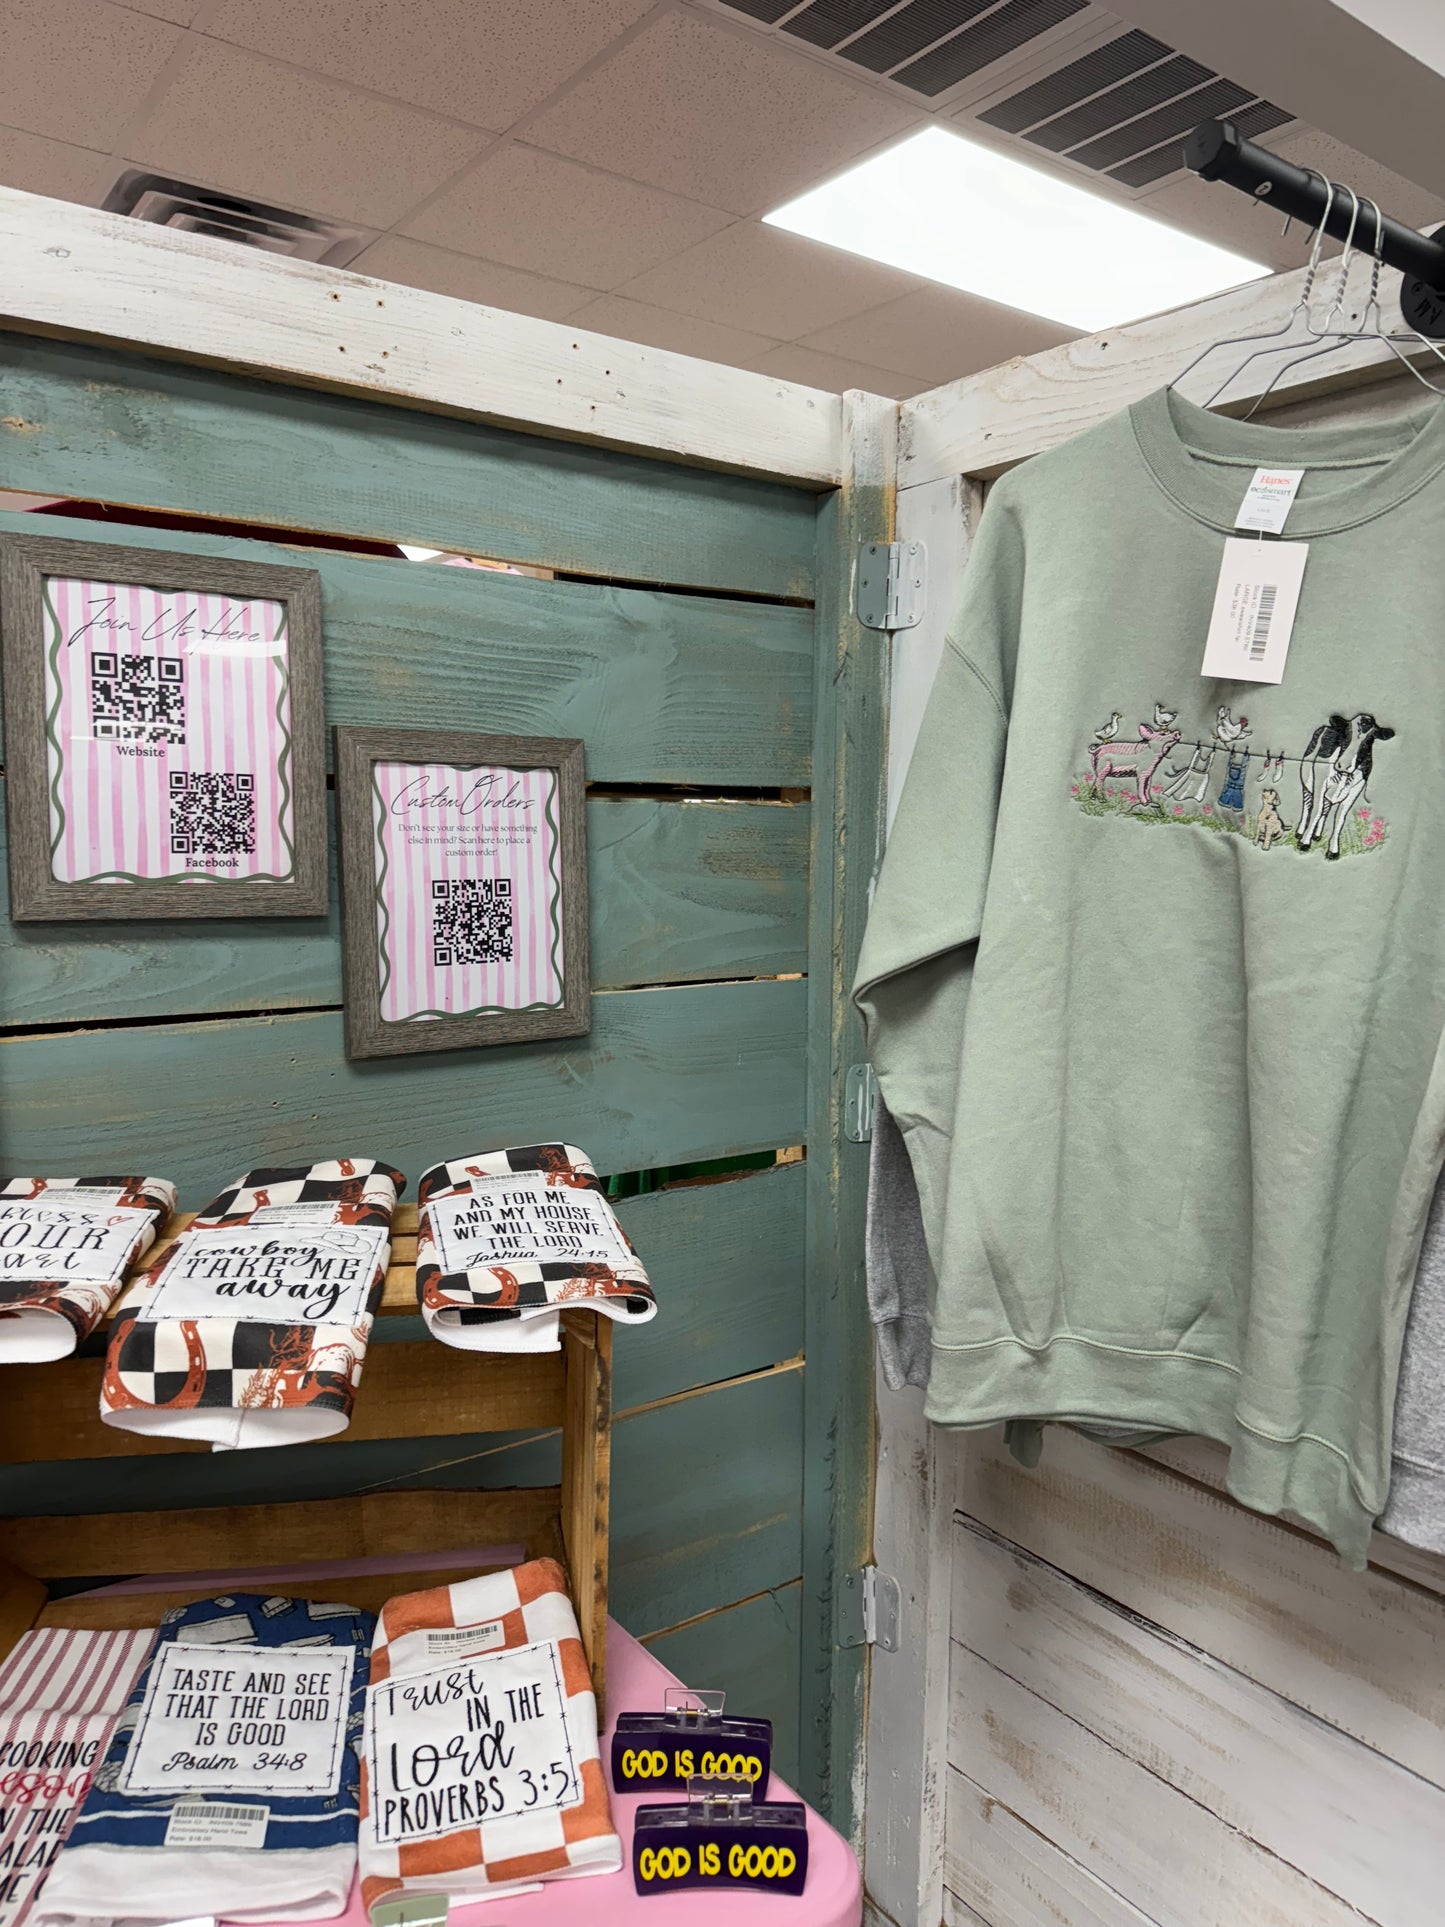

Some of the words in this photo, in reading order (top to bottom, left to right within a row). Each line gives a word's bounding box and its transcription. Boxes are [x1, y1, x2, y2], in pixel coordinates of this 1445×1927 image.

[1260, 475, 1291, 485] Hanes
[68, 597, 137, 647] Join
[142, 607, 196, 642] Us
[189, 607, 261, 656] Here
[116, 745, 165, 758] Website
[391, 775, 461, 815] Custom
[460, 774, 536, 816] Orders
[408, 836, 423, 844] else
[425, 836, 432, 844] in
[434, 836, 457, 844] mind?
[458, 836, 477, 844] Scan
[478, 836, 495, 844] here
[497, 836, 504, 844] to
[506, 836, 524, 845] place
[437, 826, 455, 834] your
[482, 824, 498, 832] have
[500, 824, 537, 834] something
[185, 857, 239, 869] Facebook
[475, 848, 498, 856] order!
[469, 1197, 494, 1209] AS
[504, 1192, 536, 1207] FOR
[544, 1191, 570, 1205] ME
[454, 1209, 492, 1226] AND
[500, 1207, 529, 1221] MY
[535, 1206, 595, 1221] HOUSE
[0, 1222, 110, 1250] OUR
[453, 1225, 484, 1241] WE
[492, 1222, 539, 1237] WILL
[546, 1220, 604, 1237] SERVE
[487, 1235, 526, 1250] THE
[532, 1235, 583, 1248] LORD
[0, 1251, 80, 1270] art
[195, 1240, 325, 1267] cowboy
[465, 1249, 538, 1268] Joshua
[182, 1257, 288, 1279] TAKE
[305, 1258, 362, 1280] ME
[216, 1279, 351, 1320] away
[171, 1667, 237, 1692] TASTE
[241, 1672, 286, 1695] AND
[294, 1672, 333, 1695] SEE
[378, 1669, 485, 1716] Trust
[164, 1693, 220, 1718] THAT
[229, 1694, 272, 1719] THE
[276, 1697, 331, 1721] LORD
[467, 1698, 492, 1732] IN
[505, 1682, 545, 1724] THE
[194, 1721, 218, 1746] IS
[227, 1723, 286, 1746] GOOD
[0, 1740, 99, 1769] COOKING
[161, 1751, 239, 1772] Psalm
[253, 1752, 308, 1772] 34:8
[621, 1749, 669, 1779] GOD
[674, 1749, 695, 1777] IS
[701, 1751, 763, 1783] GOOD
[385, 1776, 505, 1837] PROVERBS
[518, 1762, 570, 1807] 3:5
[0, 1807, 16, 1834] N
[25, 1808, 76, 1835] THE
[0, 1840, 65, 1868] ALA
[639, 1846, 692, 1881] GOD
[698, 1843, 721, 1876] IS
[728, 1844, 796, 1878] GOOD
